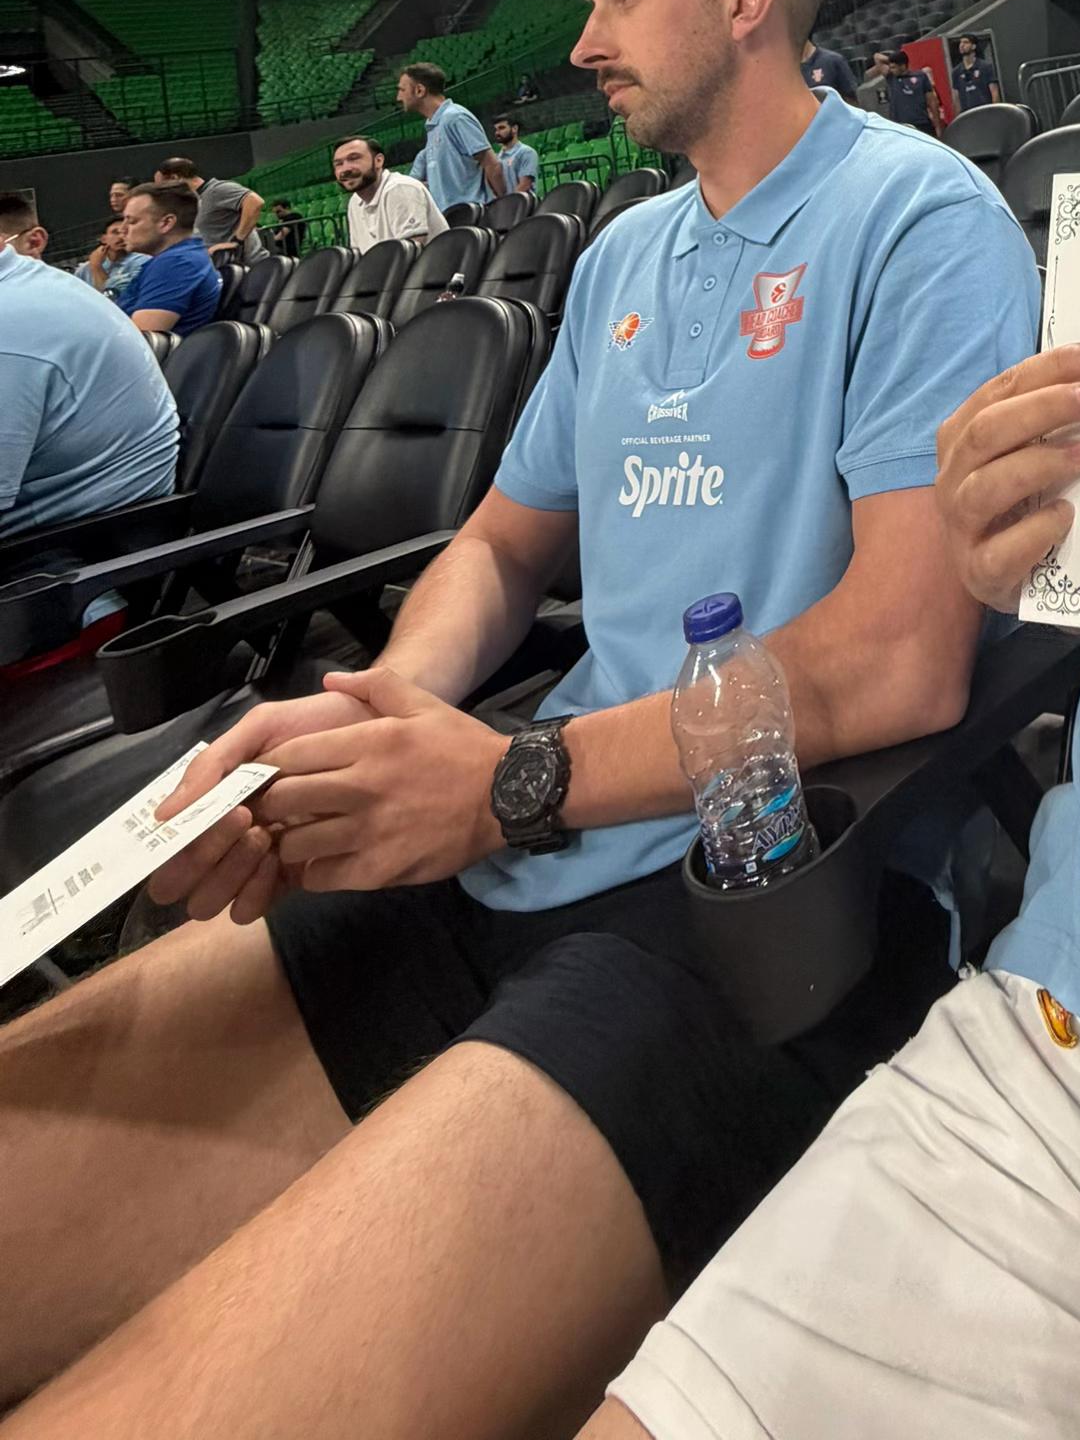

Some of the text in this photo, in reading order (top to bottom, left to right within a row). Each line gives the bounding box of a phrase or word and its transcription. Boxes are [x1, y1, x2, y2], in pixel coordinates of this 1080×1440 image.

[648, 402, 688, 423] CROSSOVER
[621, 434, 711, 446] OFFICIAL BEVERAGE PARTNER
[619, 451, 724, 518] Sprite
